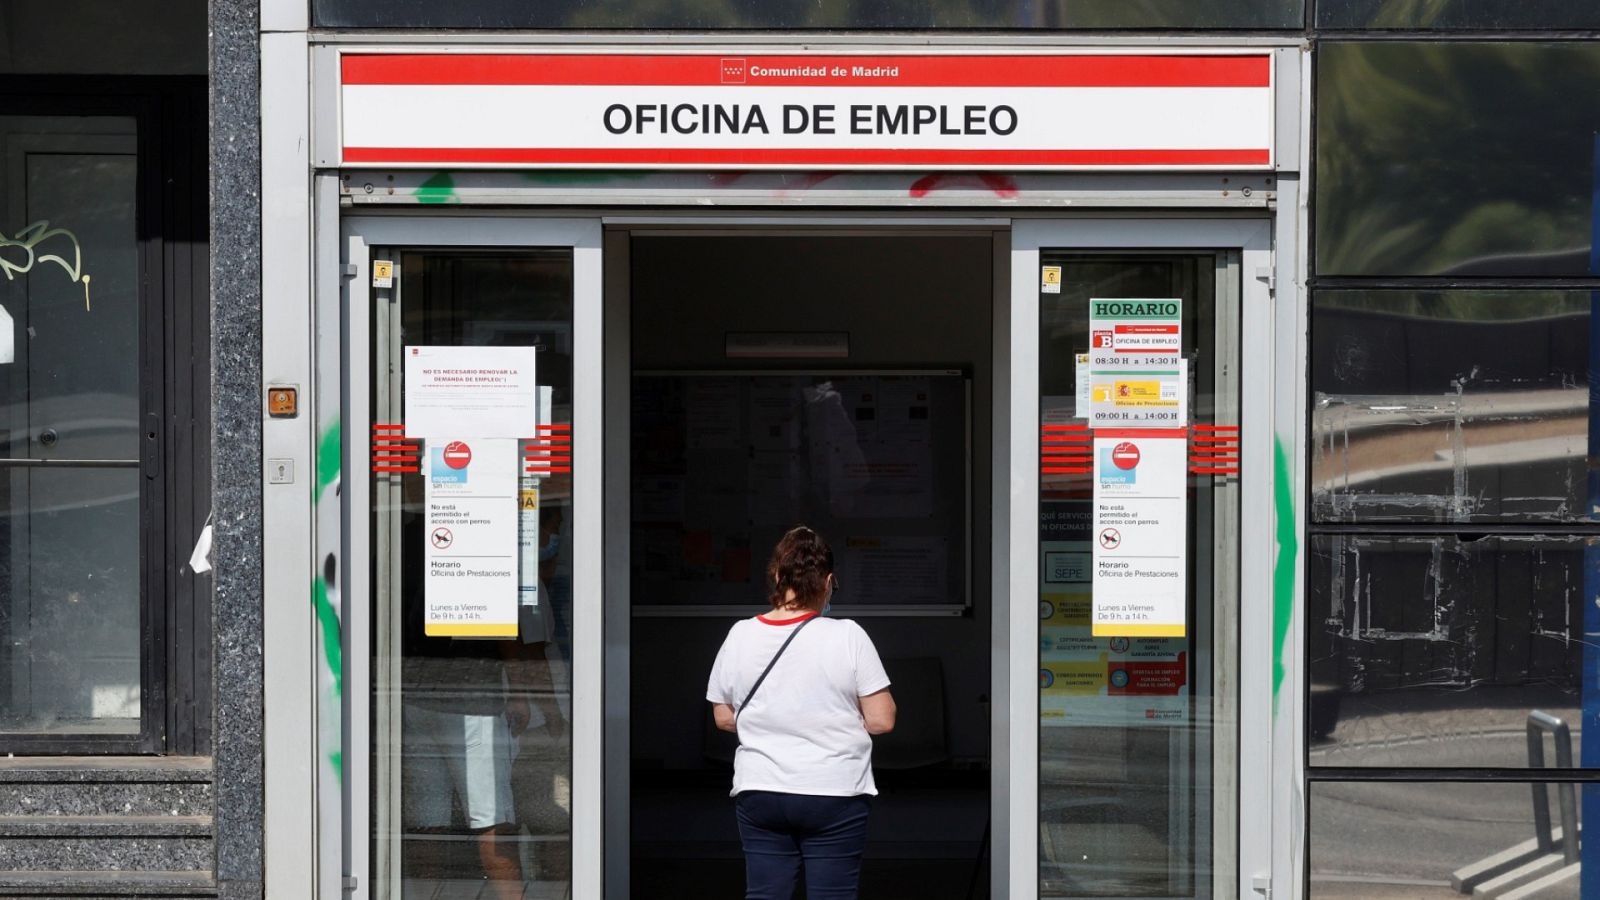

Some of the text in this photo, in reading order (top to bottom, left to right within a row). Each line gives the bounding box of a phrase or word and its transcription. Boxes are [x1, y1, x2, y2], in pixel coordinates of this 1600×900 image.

[750, 66, 899, 77] Comunidad de Madrid
[603, 103, 1018, 136] OFICINA DE EMPLEO
[1095, 303, 1178, 316] HORARIO
[1102, 336, 1112, 348] B
[1055, 569, 1083, 578] SEPE
